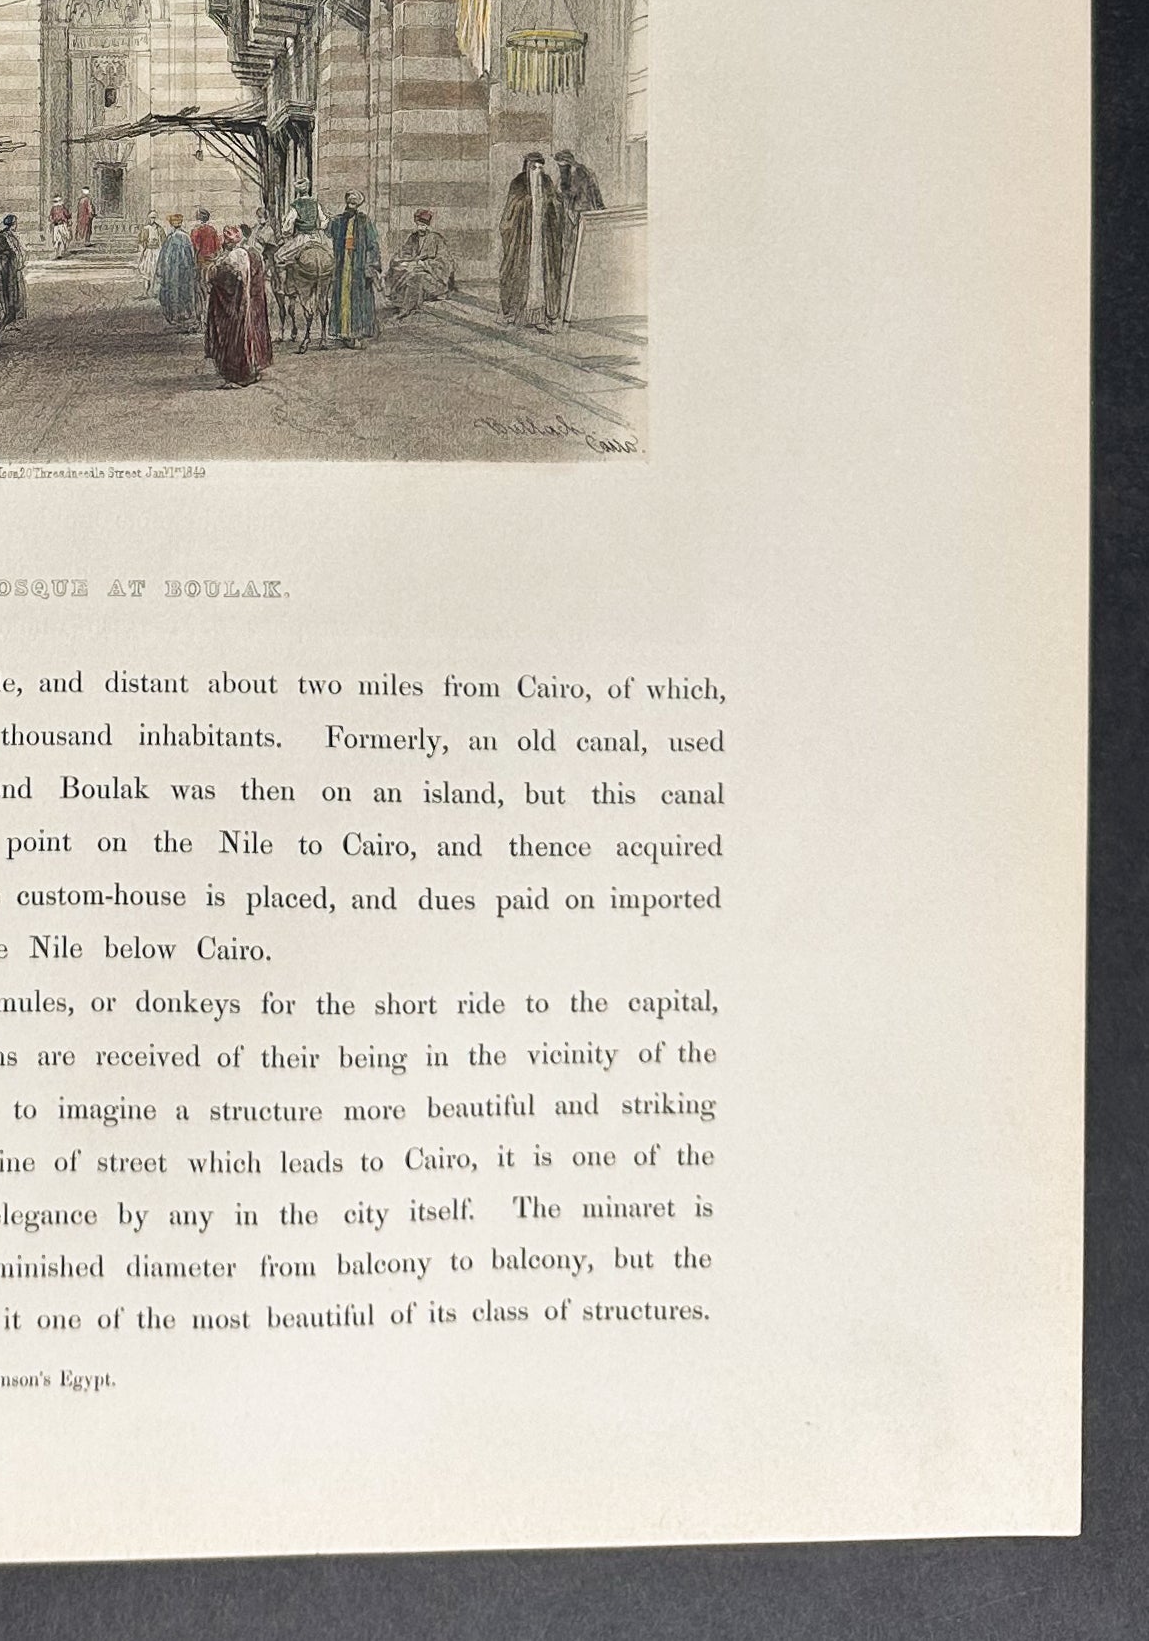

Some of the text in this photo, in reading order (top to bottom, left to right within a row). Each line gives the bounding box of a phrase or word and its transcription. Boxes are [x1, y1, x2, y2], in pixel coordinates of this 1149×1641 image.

[106, 577, 148, 599] AT
[163, 578, 292, 600] BOULAK.
[39, 670, 84, 693] and
[105, 670, 189, 694] distant
[208, 671, 278, 694] about
[298, 676, 342, 696] two
[358, 673, 424, 699] miles
[442, 674, 501, 698] from
[517, 674, 591, 703] Cairo,
[608, 676, 635, 700] of
[646, 677, 726, 704] which,
[0, 723, 113, 748] thousand
[139, 723, 281, 749] inhabitants.
[325, 725, 449, 760] Formerly,
[469, 736, 498, 752] an
[517, 728, 557, 753] old
[576, 729, 648, 757] canal,
[668, 729, 725, 753] used
[5, 829, 72, 862] point
[97, 837, 127, 854] on
[154, 829, 193, 855] the
[218, 830, 273, 856] Nile
[298, 835, 322, 856] to
[343, 832, 417, 862] Cairo,
[436, 833, 482, 860] and
[509, 834, 592, 859] thence
[617, 833, 723, 866] acquired
[29, 934, 83, 960] Nile
[103, 935, 177, 962] below
[197, 935, 271, 964] Cairo.
[91, 997, 117, 1014] or
[136, 989, 240, 1023] donkeys
[261, 991, 296, 1016] for
[316, 992, 355, 1017] the
[375, 992, 437, 1016] short
[457, 991, 505, 1016] ride
[526, 995, 549, 1014] to
[571, 990, 608, 1014] the
[628, 989, 718, 1021] capital,
[14, 1100, 37, 1120] to
[58, 1096, 156, 1128] imagine
[176, 1105, 189, 1121] a
[210, 1102, 322, 1124] structure
[344, 1105, 406, 1122] more
[427, 1093, 535, 1118] beautiful
[555, 1092, 599, 1117] and
[622, 1092, 717, 1123] striking
[117, 1202, 149, 1234] by
[169, 1210, 214, 1234] any
[235, 1202, 258, 1227] in
[279, 1202, 318, 1227] the
[344, 1201, 389, 1233] city
[410, 1197, 474, 1223] itself.
[512, 1196, 561, 1220] The
[583, 1195, 676, 1220] minaret
[695, 1194, 713, 1218] is
[4, 1307, 22, 1332] it
[37, 1314, 81, 1331] one
[98, 1306, 125, 1331] of
[136, 1306, 175, 1331] the
[192, 1310, 250, 1331] most
[267, 1303, 374, 1330] beautiful
[390, 1301, 417, 1325] of
[429, 1300, 457, 1325] its
[472, 1299, 528, 1322] class
[544, 1298, 572, 1321] of
[583, 1302, 709, 1322] structures.
[60, 1370, 116, 1393] Egypt.
